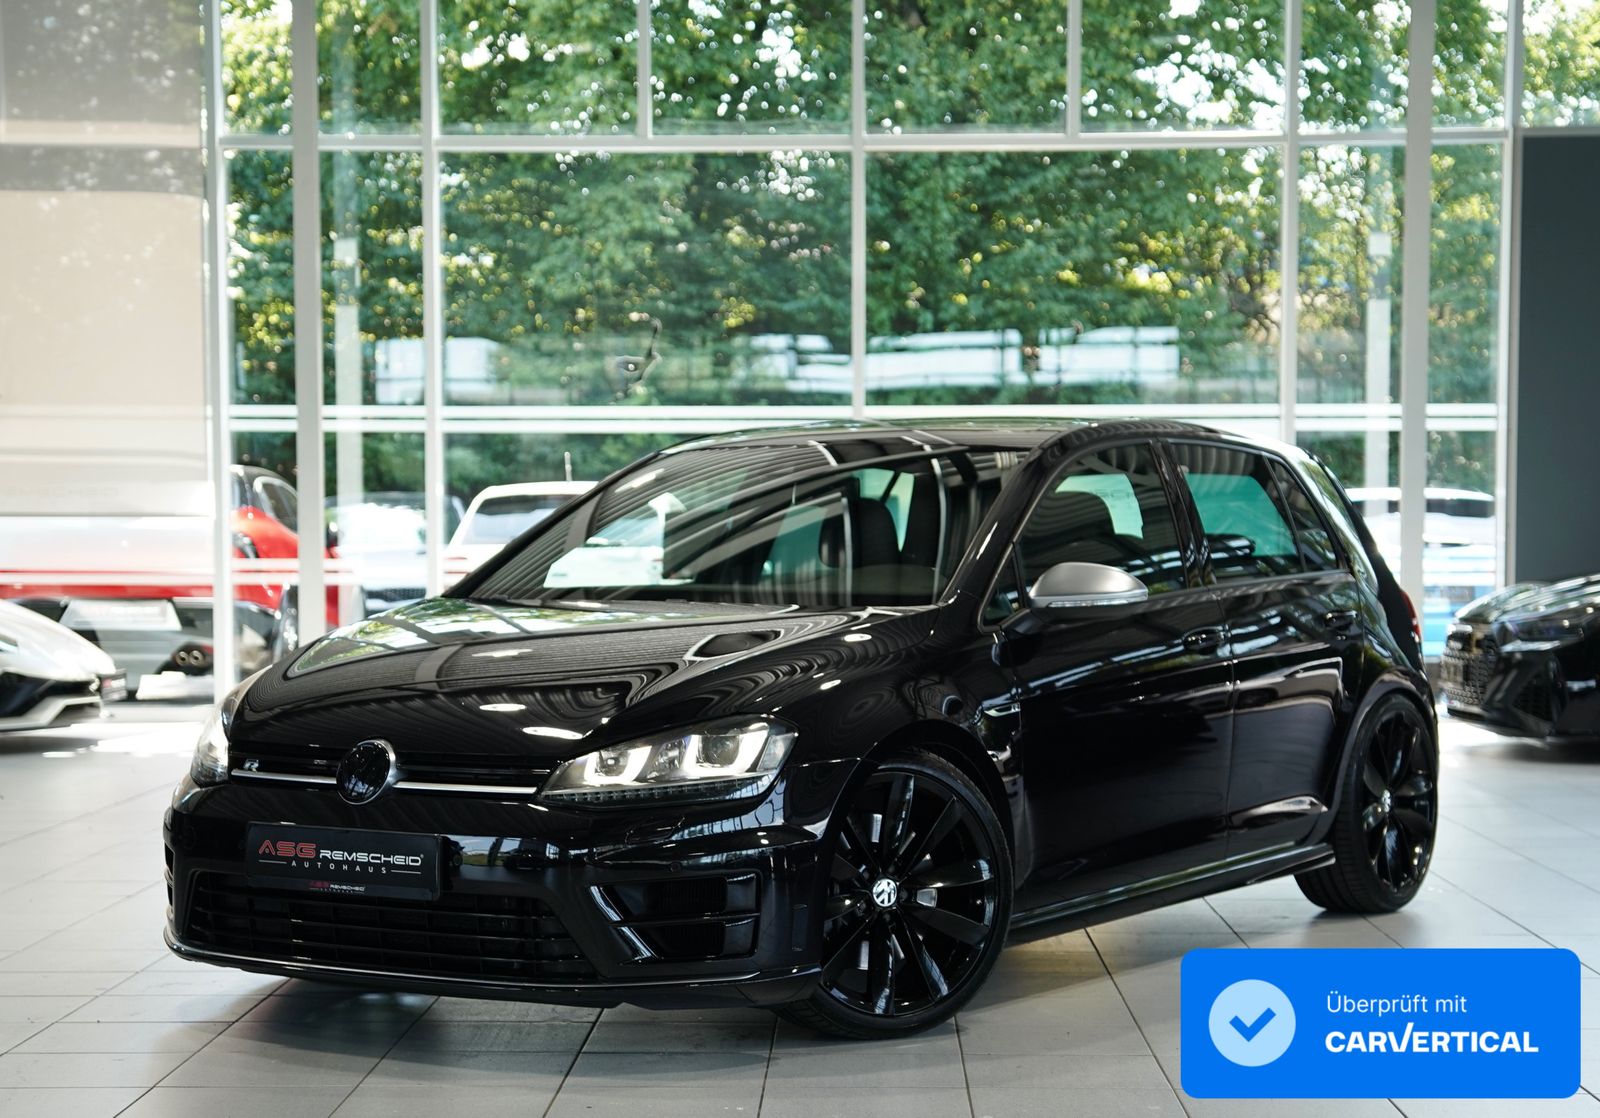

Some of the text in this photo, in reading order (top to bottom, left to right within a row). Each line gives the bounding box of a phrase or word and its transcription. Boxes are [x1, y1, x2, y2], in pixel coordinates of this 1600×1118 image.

[258, 839, 422, 866] ASG REMSCHEID
[291, 860, 387, 874] AUTOHAUS
